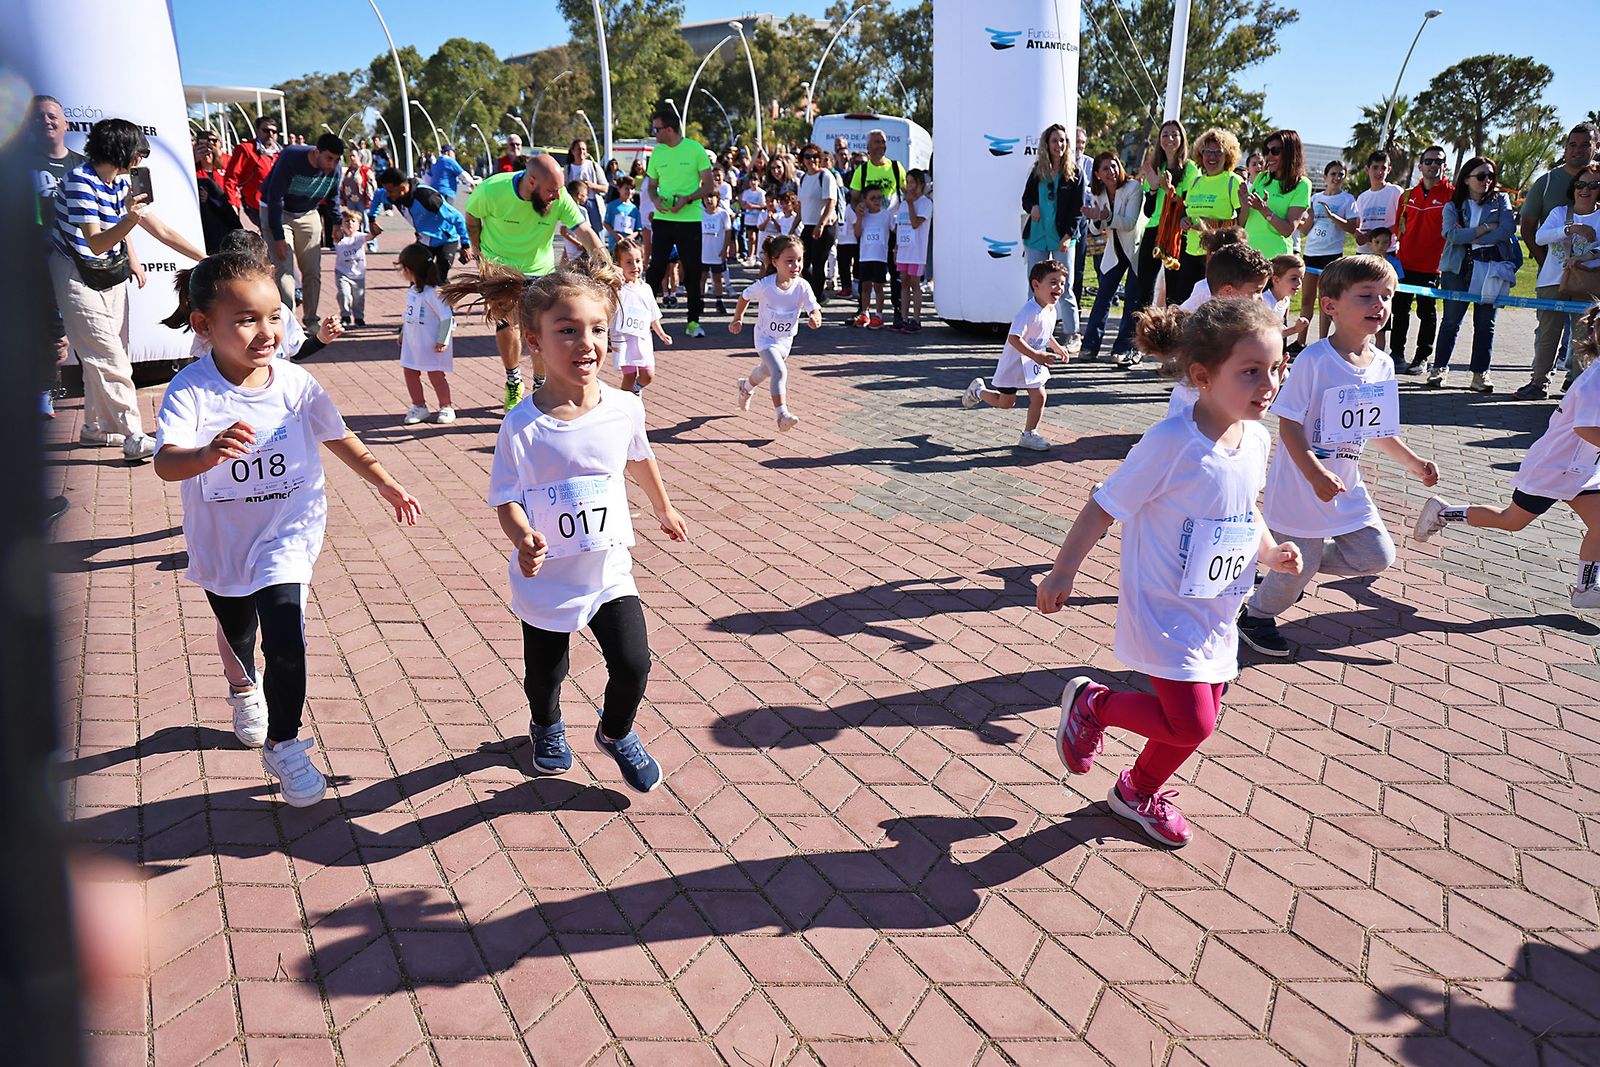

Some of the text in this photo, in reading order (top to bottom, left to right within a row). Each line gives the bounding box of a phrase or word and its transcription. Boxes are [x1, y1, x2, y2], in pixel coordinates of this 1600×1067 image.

[63, 105, 104, 119] ación
[866, 233, 880, 242] 033
[1314, 228, 1327, 238] 136
[140, 262, 177, 272] OPPER
[626, 317, 645, 331] 050
[769, 321, 792, 333] 062
[1341, 406, 1381, 429] 012
[231, 453, 287, 483] 018
[558, 506, 608, 539] 017
[1208, 555, 1245, 581] 016
